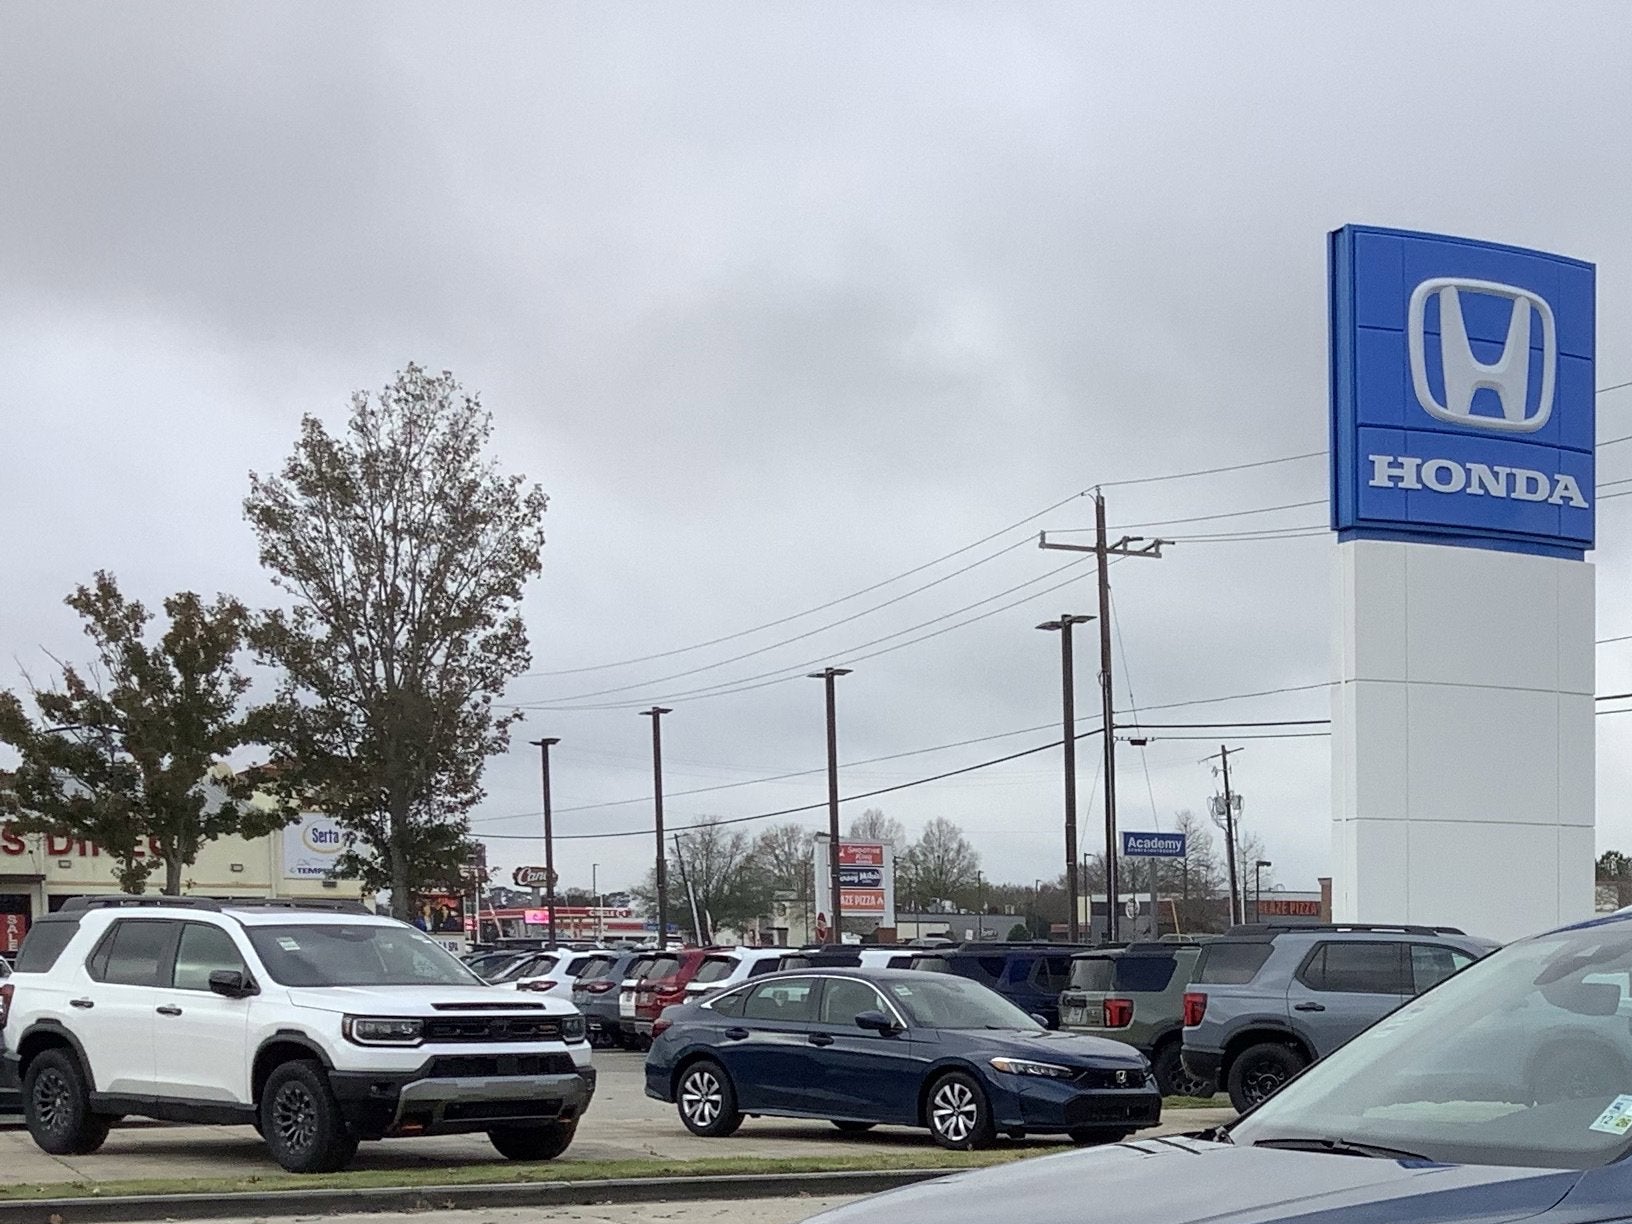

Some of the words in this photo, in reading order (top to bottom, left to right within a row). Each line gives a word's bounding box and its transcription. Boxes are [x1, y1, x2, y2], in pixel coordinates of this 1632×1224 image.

[1368, 454, 1590, 509] HONDA
[311, 827, 339, 844] Serta
[1127, 836, 1182, 852] Academy
[855, 894, 876, 906] PIZZA
[1289, 902, 1318, 915] PIZZA
[7, 914, 19, 952] SALE
